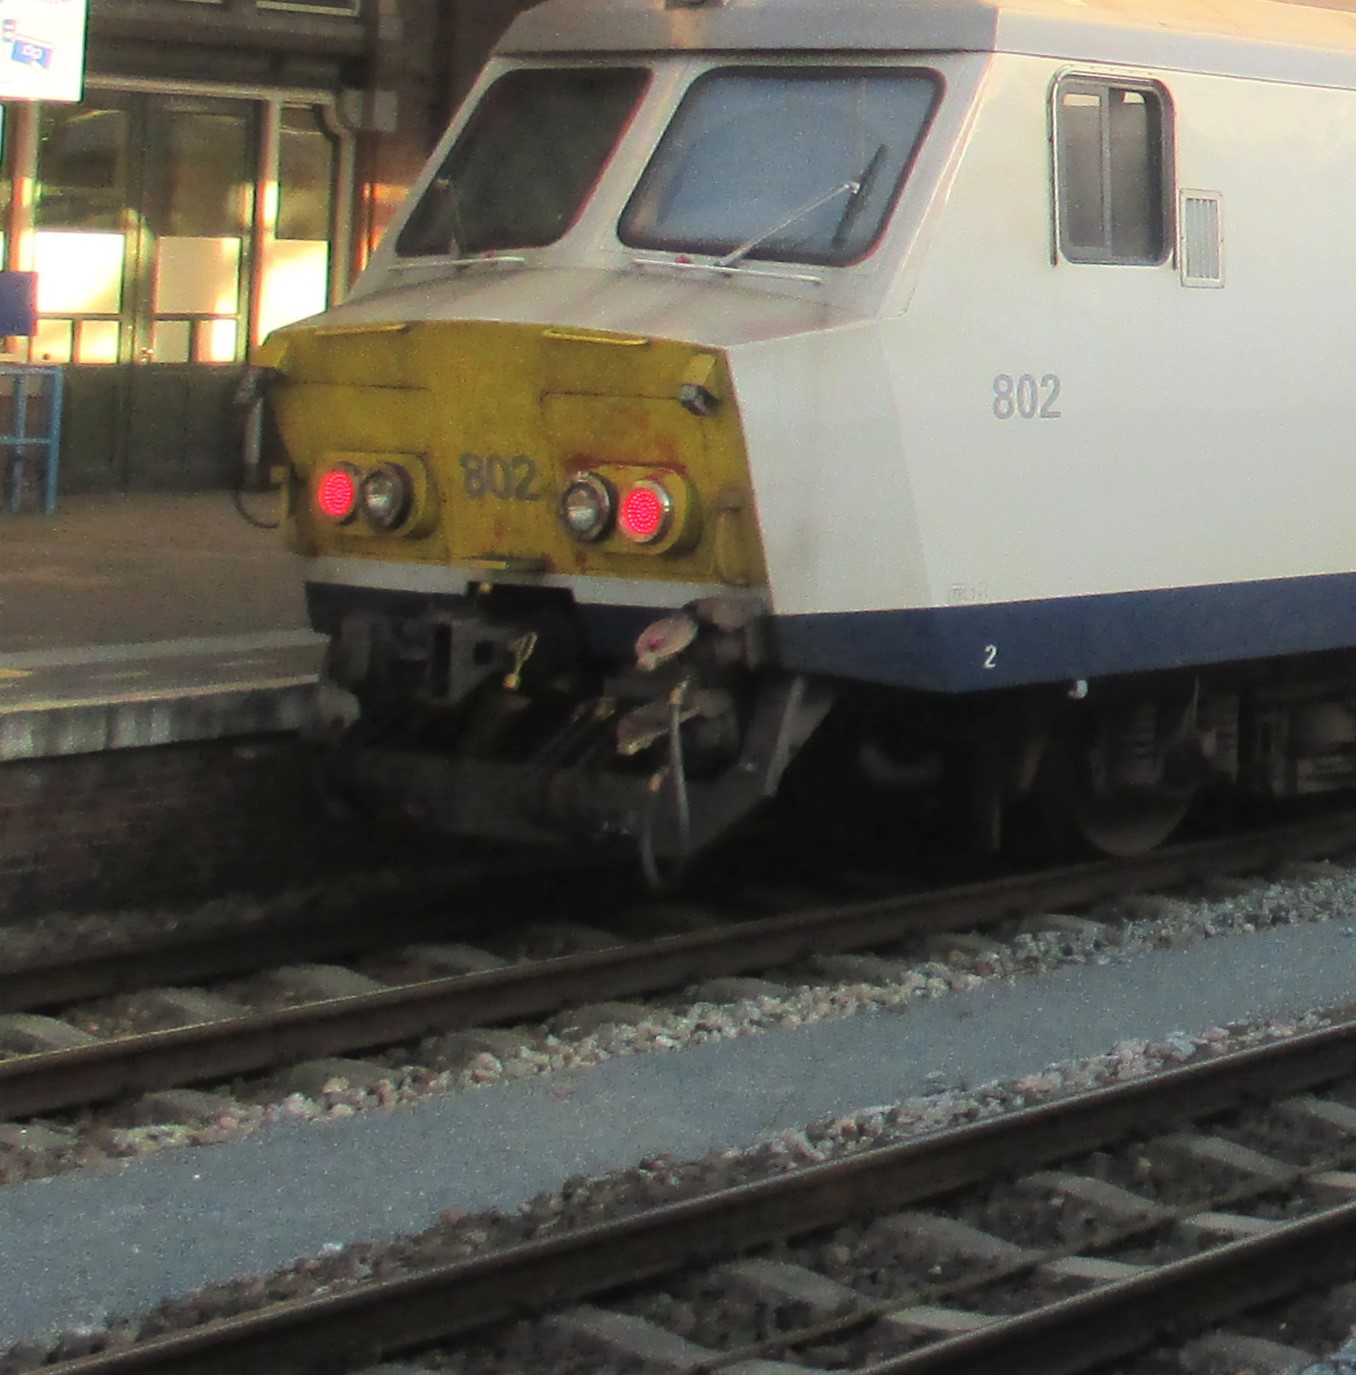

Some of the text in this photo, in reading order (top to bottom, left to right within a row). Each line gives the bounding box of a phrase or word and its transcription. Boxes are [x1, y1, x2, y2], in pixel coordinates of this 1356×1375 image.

[992, 373, 1062, 420] 802
[459, 453, 541, 501] 802
[984, 644, 997, 669] 2
